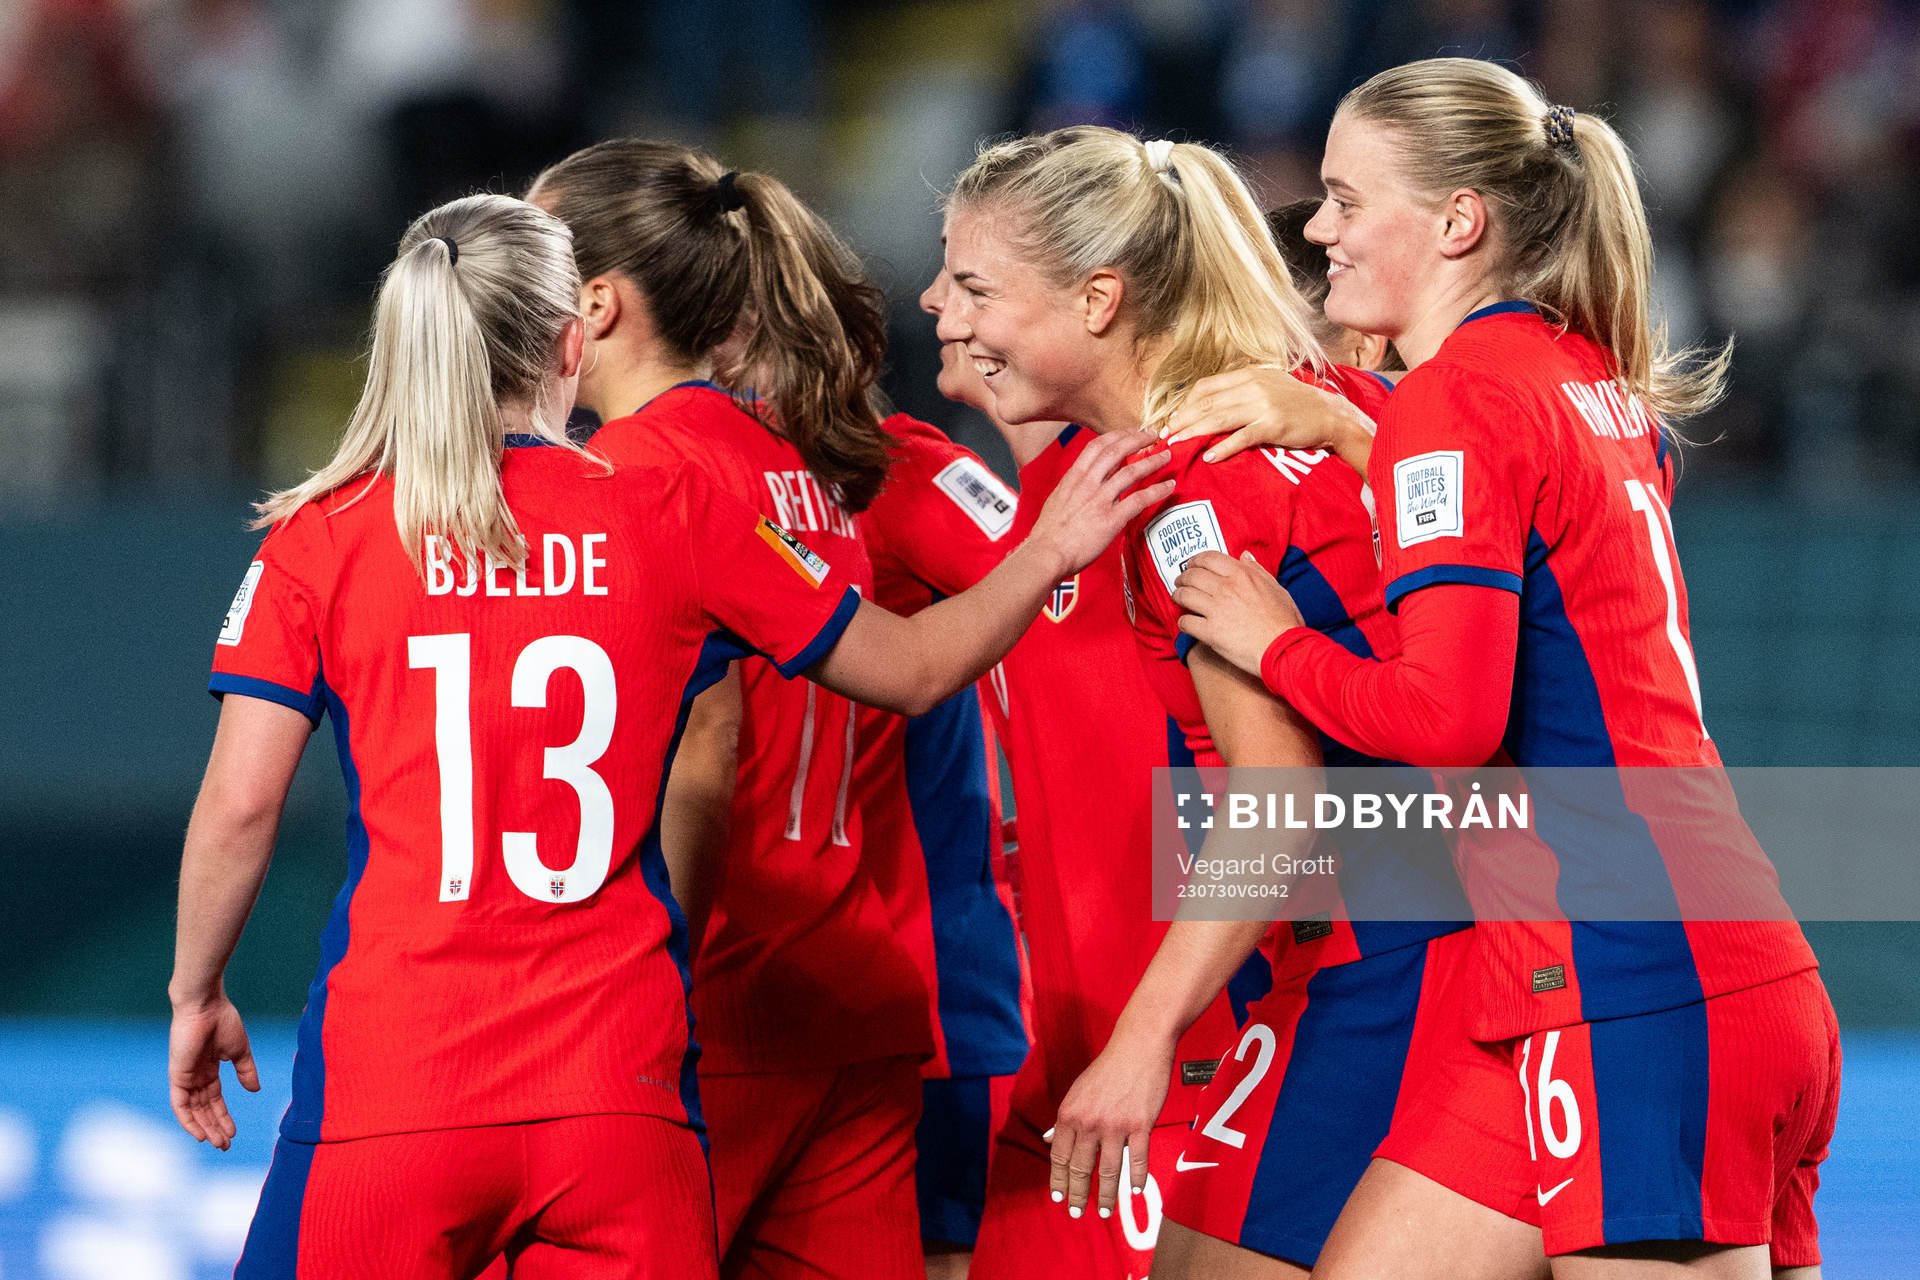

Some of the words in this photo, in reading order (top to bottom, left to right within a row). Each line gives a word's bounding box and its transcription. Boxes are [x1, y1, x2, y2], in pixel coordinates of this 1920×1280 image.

[1407, 466, 1445, 485] FOOTBALL
[1407, 477, 1445, 500] UNITES
[1158, 515, 1198, 540] FOOTBALL
[1161, 524, 1203, 554] UNITES
[425, 533, 609, 597] BJELDE
[1165, 553, 1180, 568] the
[1179, 536, 1208, 558] World
[1624, 479, 1710, 741] 1
[407, 633, 618, 903] 13
[1519, 1030, 1582, 1161] 16
